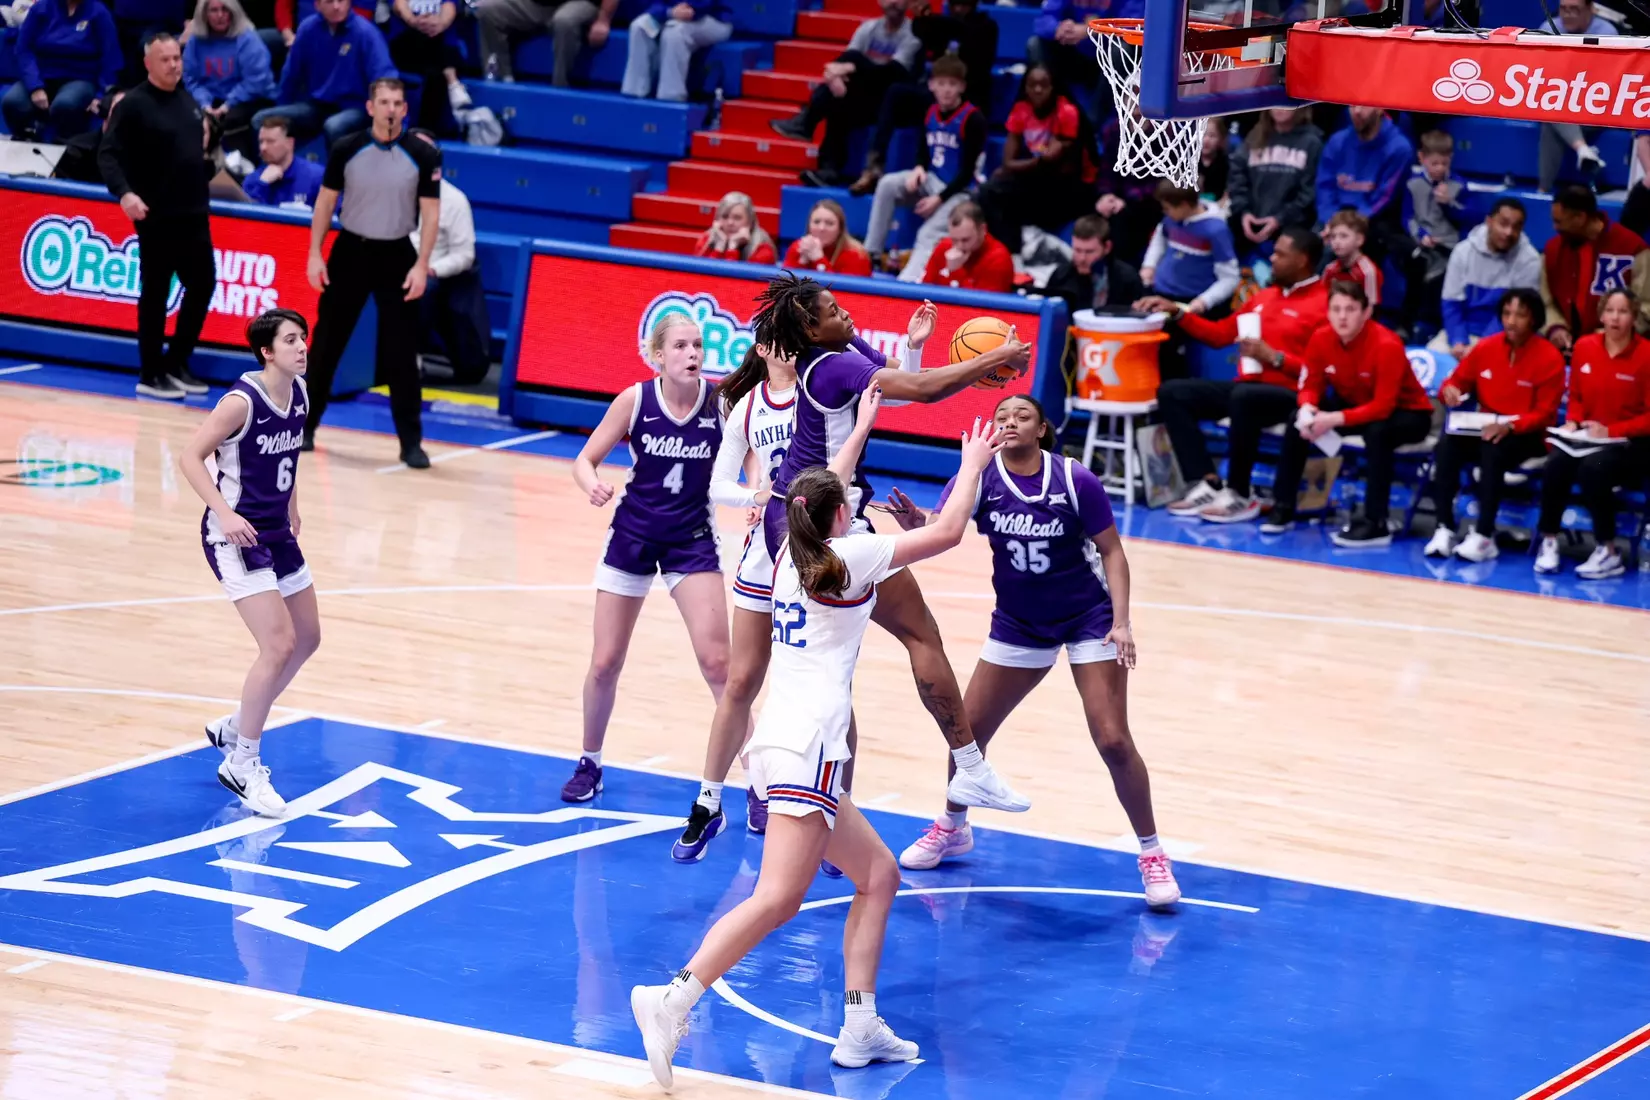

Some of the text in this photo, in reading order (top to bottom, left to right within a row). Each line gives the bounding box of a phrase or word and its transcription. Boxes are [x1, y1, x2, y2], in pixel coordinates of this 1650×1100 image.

[1499, 63, 1650, 118] State Fa
[1590, 253, 1634, 296] K
[208, 281, 279, 317] ARTS
[256, 427, 304, 455] Wildcat
[641, 433, 712, 459] Wildcats
[755, 422, 792, 448] JAYHA
[276, 456, 293, 492] 6
[662, 462, 685, 495] 4
[989, 511, 1065, 537] Wildcats
[1006, 539, 1051, 574] 35
[773, 599, 807, 648] 52
